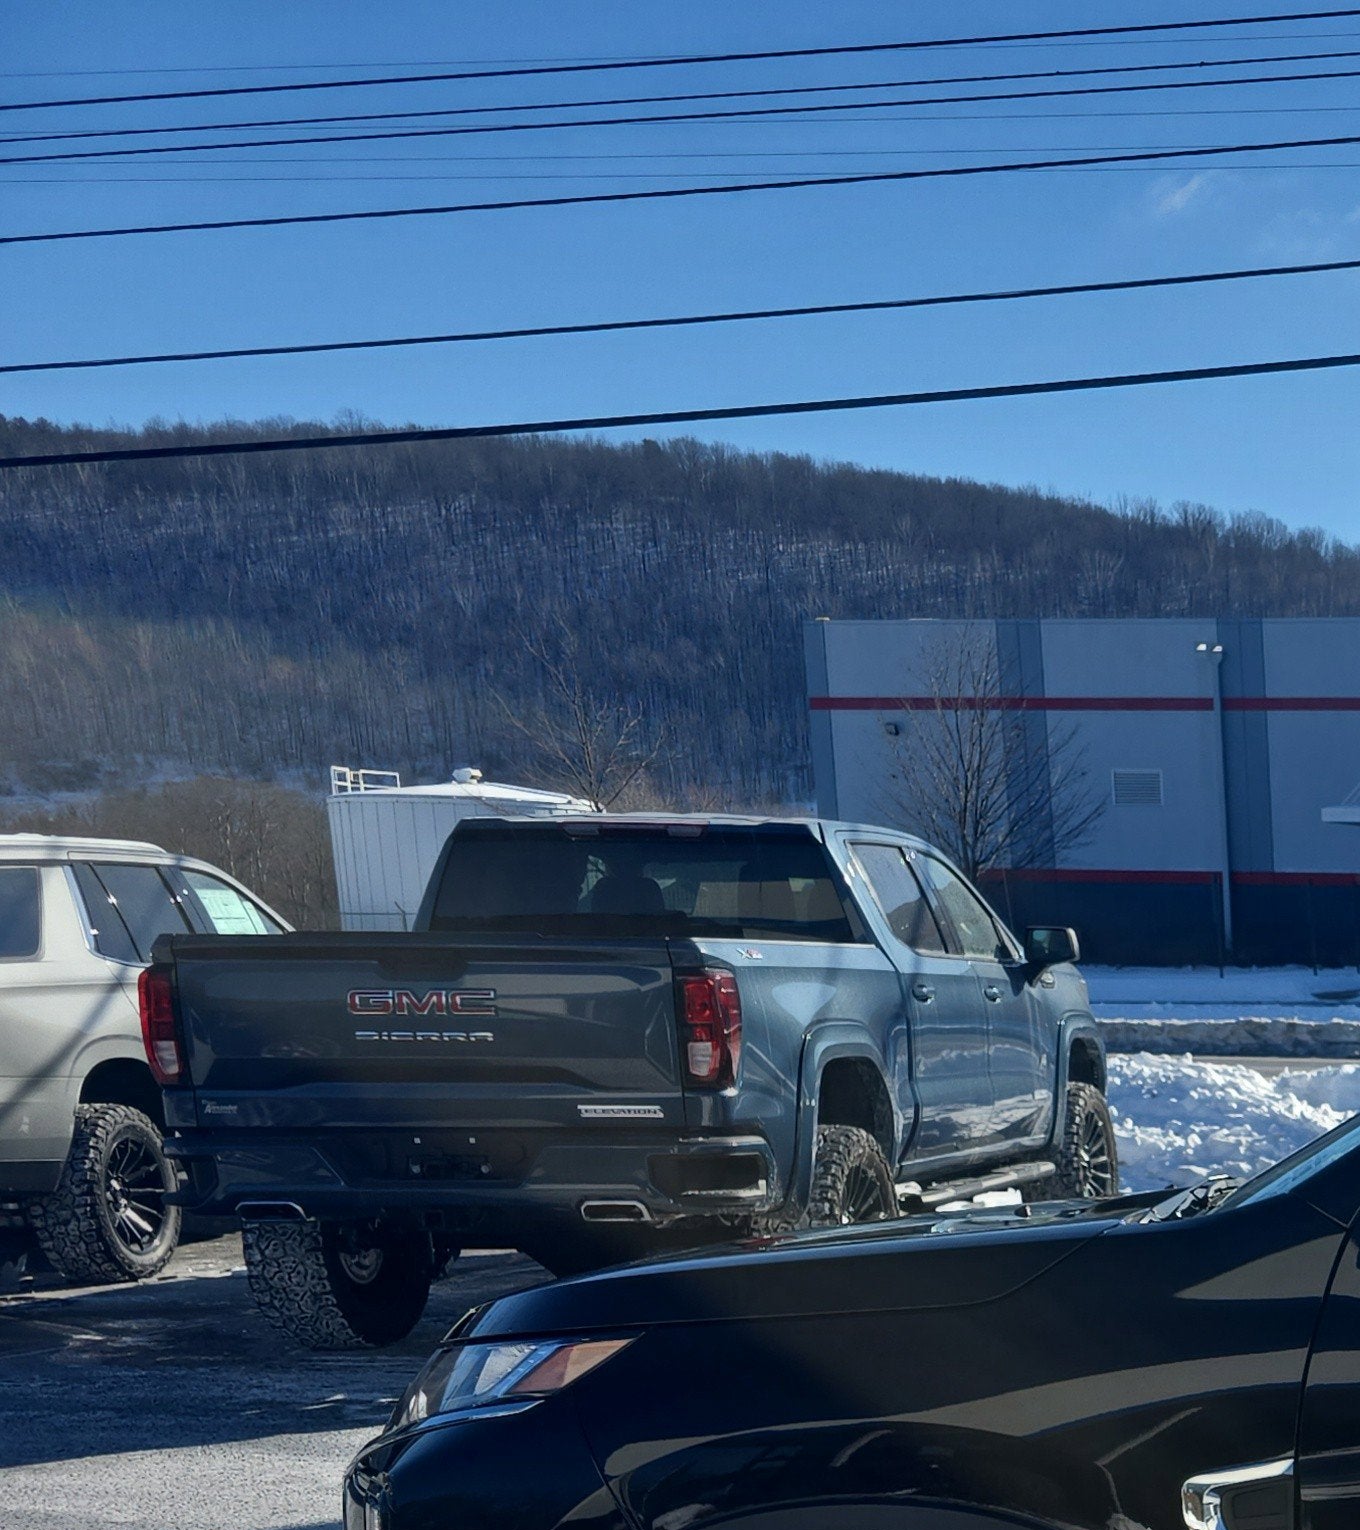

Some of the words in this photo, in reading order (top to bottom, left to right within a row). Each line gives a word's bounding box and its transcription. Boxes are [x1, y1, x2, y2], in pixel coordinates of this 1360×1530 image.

[348, 989, 496, 1016] GMC
[355, 1031, 495, 1042] SIERRA
[579, 1106, 662, 1116] ELEVATION
